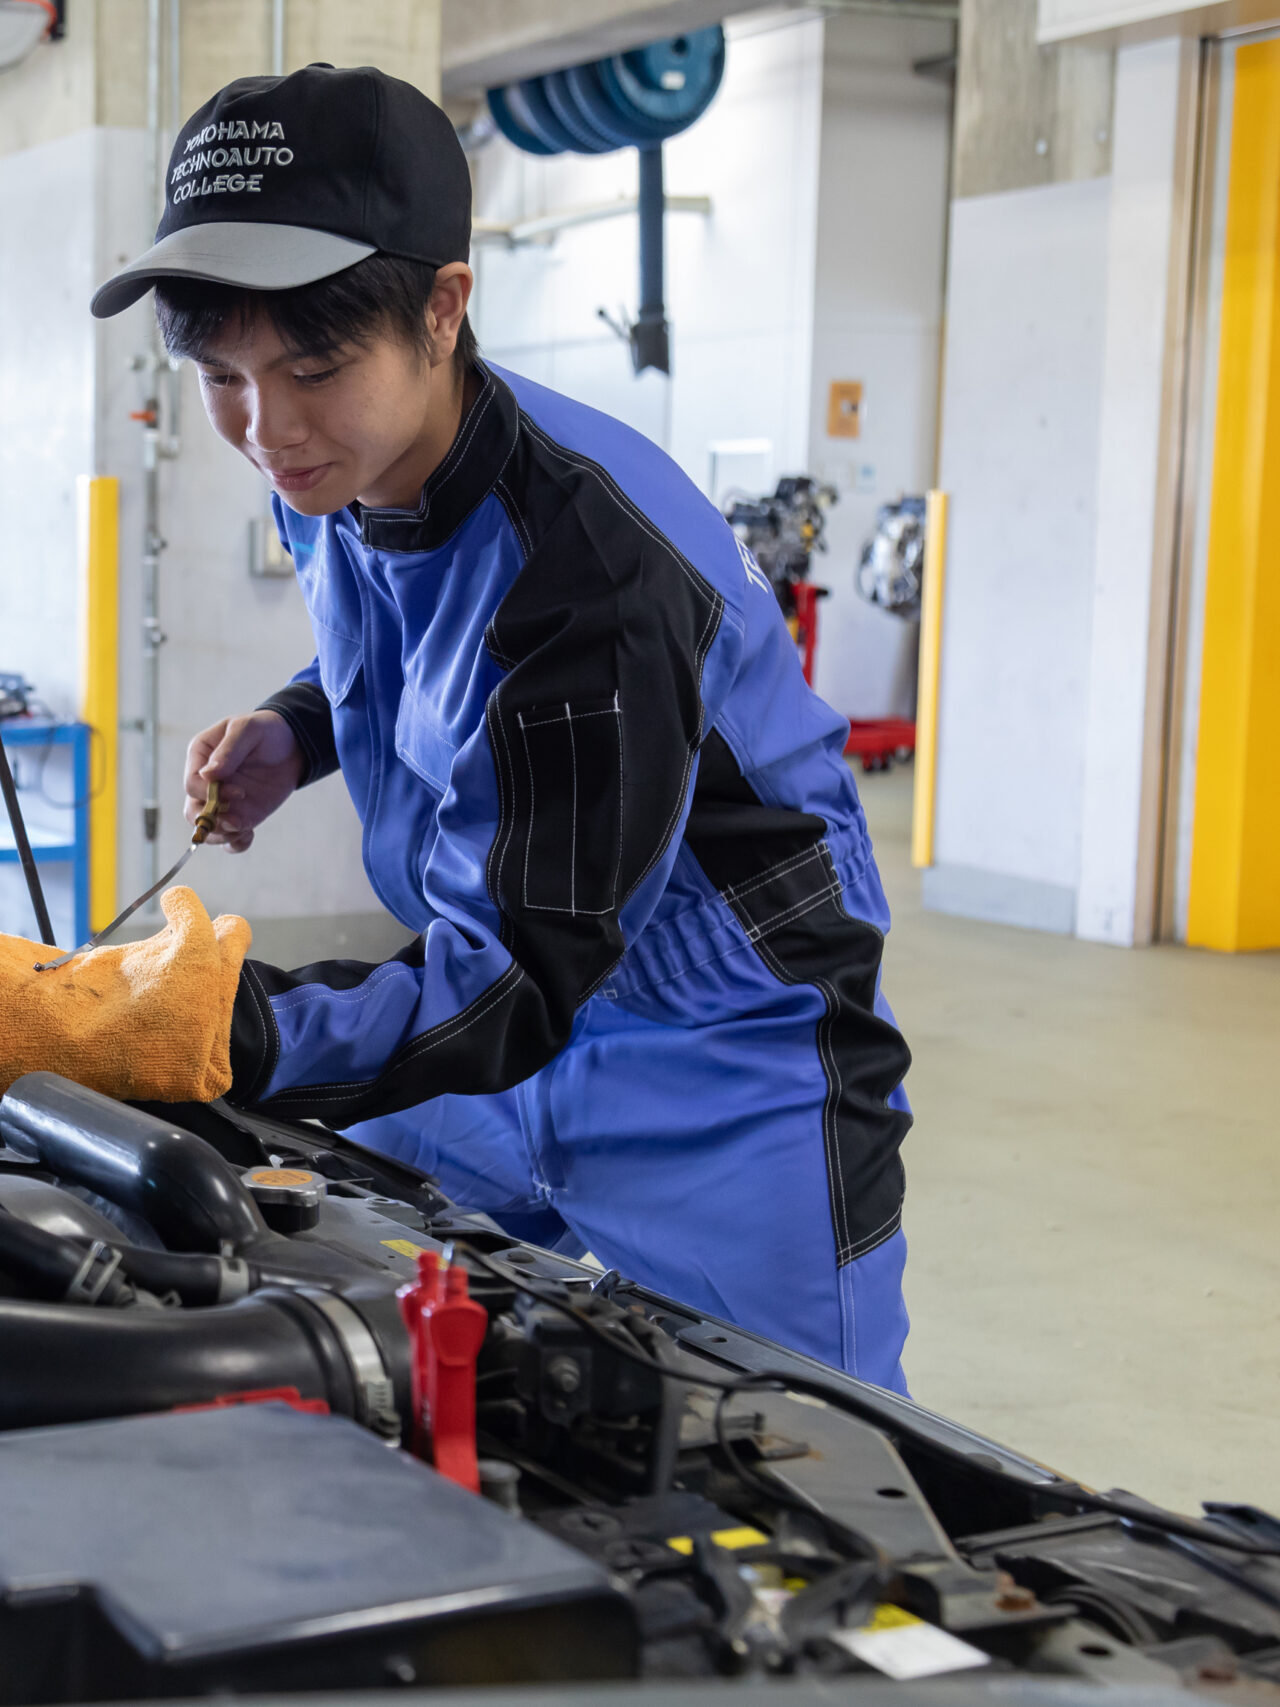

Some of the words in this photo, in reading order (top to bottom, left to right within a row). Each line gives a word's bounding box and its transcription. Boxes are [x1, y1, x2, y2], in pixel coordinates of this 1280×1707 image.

[183, 120, 285, 155] YOKOHAMA
[170, 147, 294, 185] TECHNOAUTO
[173, 174, 263, 205] COLLEGE
